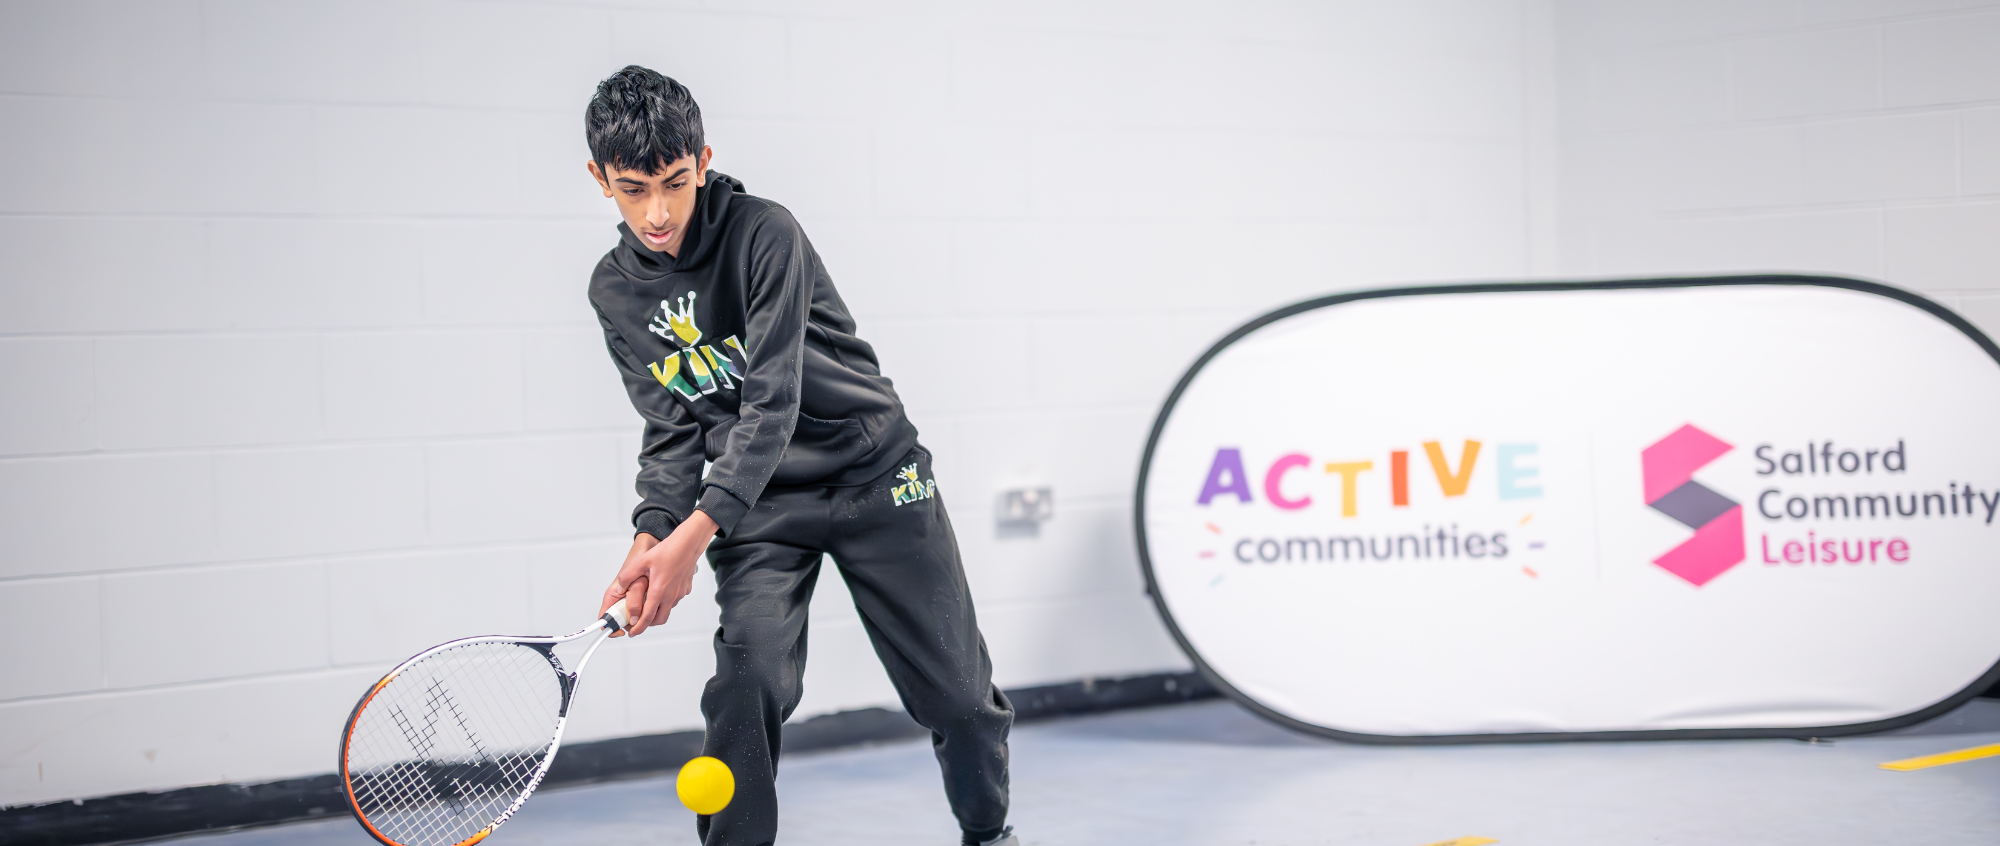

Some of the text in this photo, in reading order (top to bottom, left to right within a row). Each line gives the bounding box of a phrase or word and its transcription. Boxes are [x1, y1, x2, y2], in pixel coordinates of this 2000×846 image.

[646, 334, 747, 402] KIN
[1754, 439, 1906, 475] Salford
[891, 479, 936, 506] KING
[1196, 439, 1544, 518] ACTIVE
[1757, 481, 2000, 526] Community
[1234, 523, 1509, 564] communities
[1761, 530, 1910, 564] Leisure
